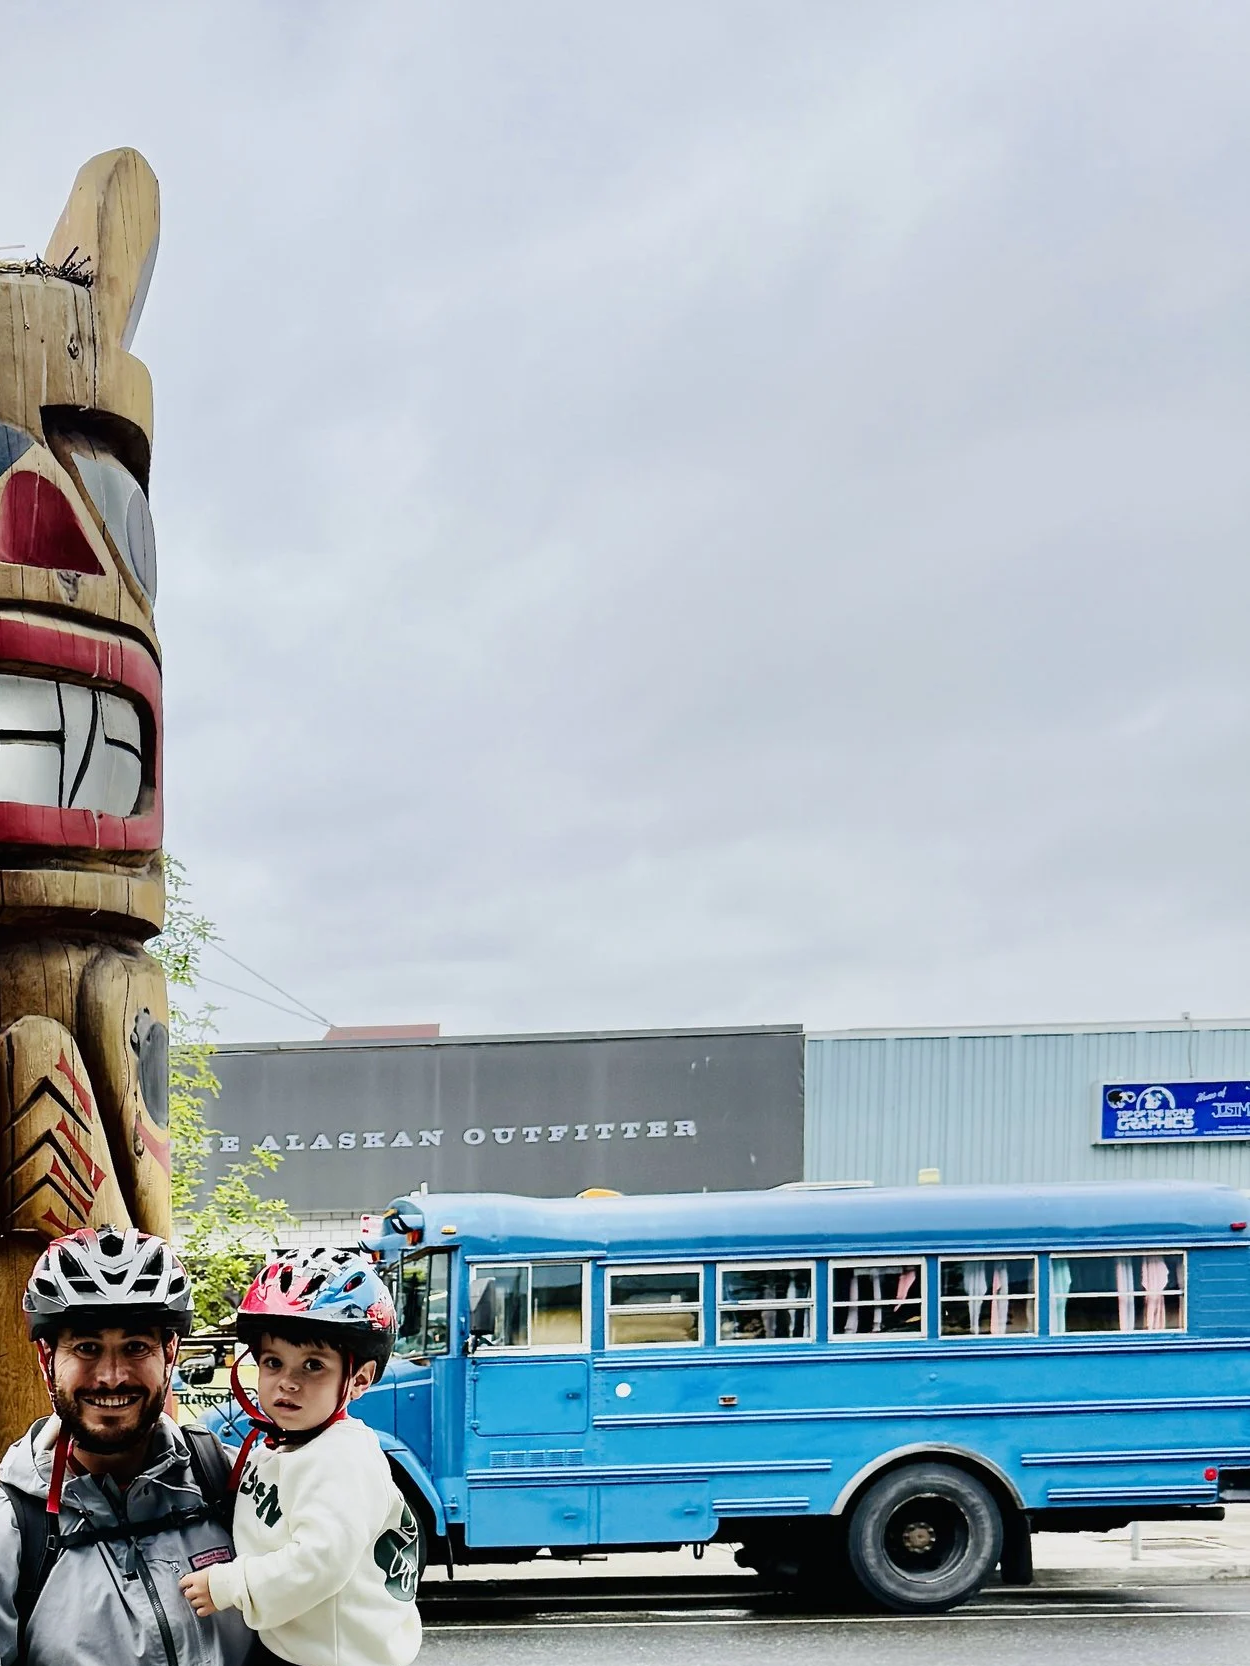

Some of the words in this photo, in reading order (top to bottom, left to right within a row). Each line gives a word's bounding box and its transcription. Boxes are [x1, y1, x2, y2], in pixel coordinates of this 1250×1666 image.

[1116, 1117, 1194, 1131] GRAPHICS
[257, 1129, 443, 1152] ALASKAN
[462, 1120, 698, 1146] OUTFITTER
